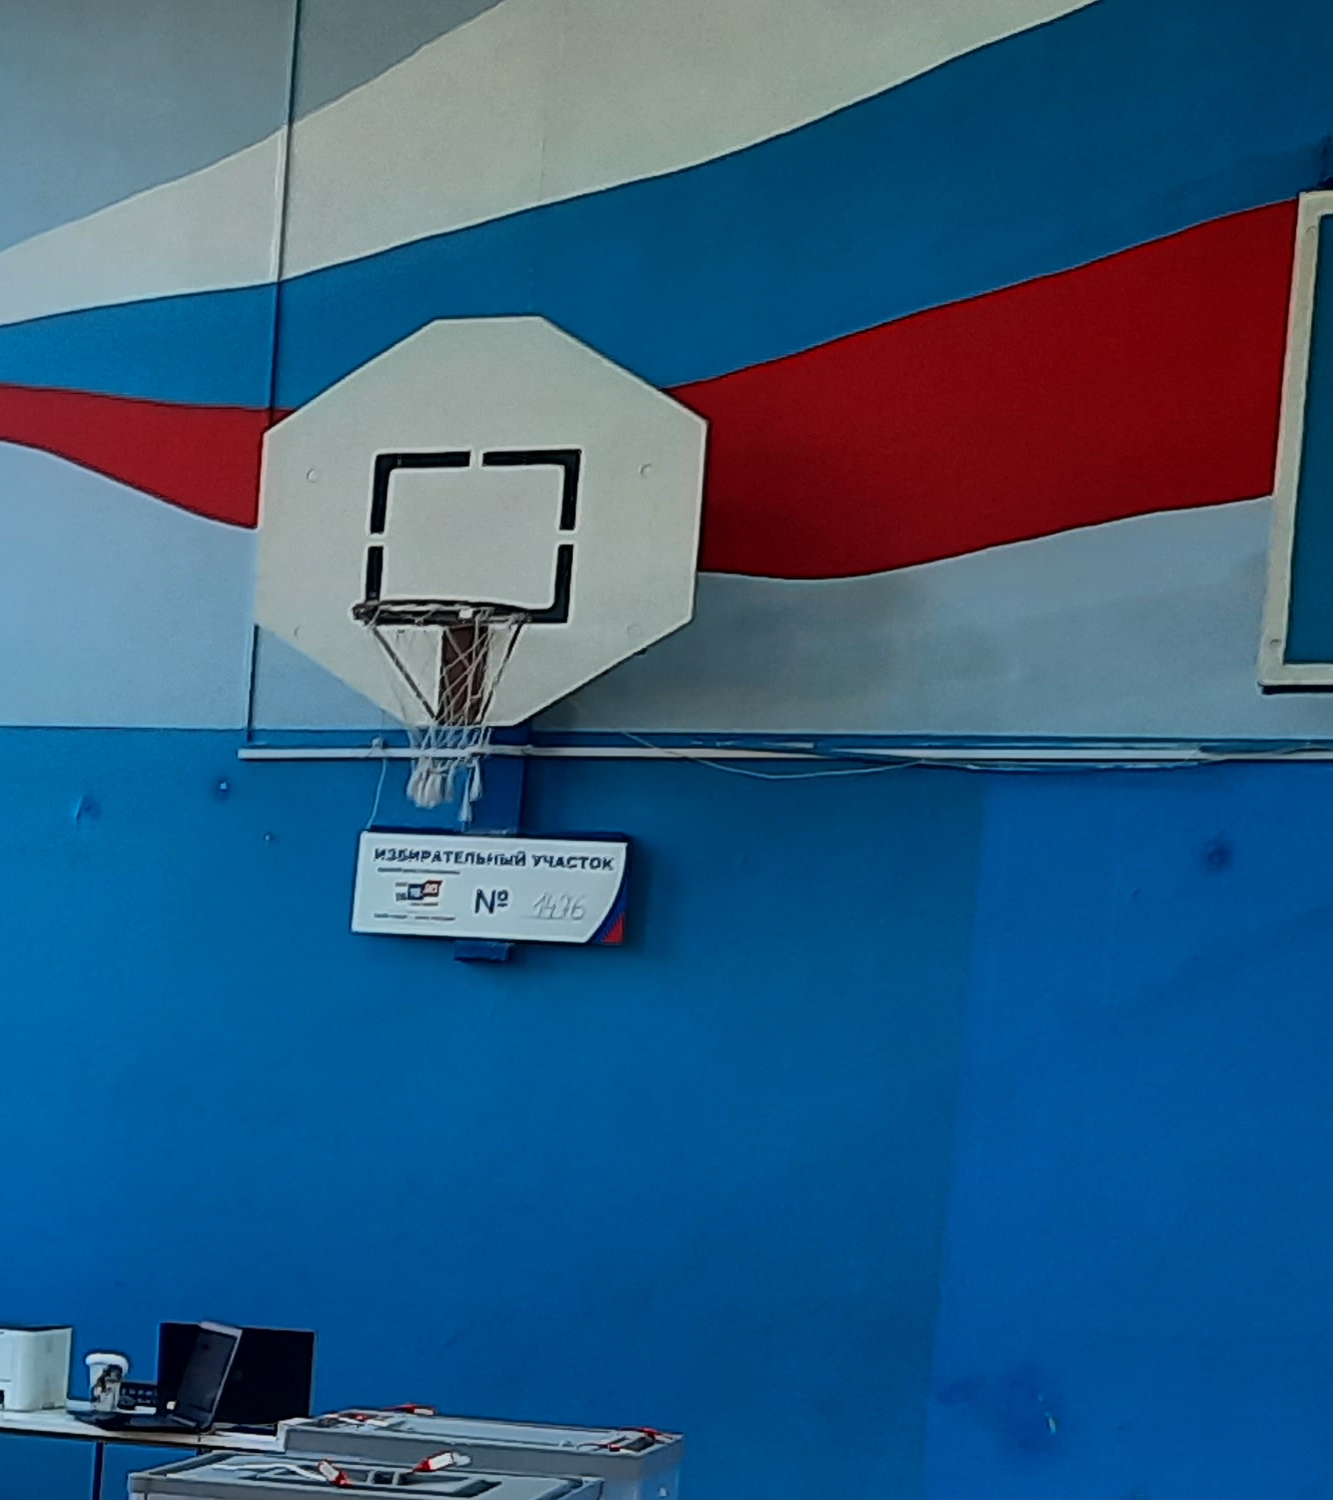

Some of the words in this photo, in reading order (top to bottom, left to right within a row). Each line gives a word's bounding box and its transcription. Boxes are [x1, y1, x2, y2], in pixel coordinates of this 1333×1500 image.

[373, 847, 527, 867] ИЗБИРАТЕЛЬНЫЙ
[532, 853, 615, 871] УЧАСТОК
[474, 888, 509, 914] №
